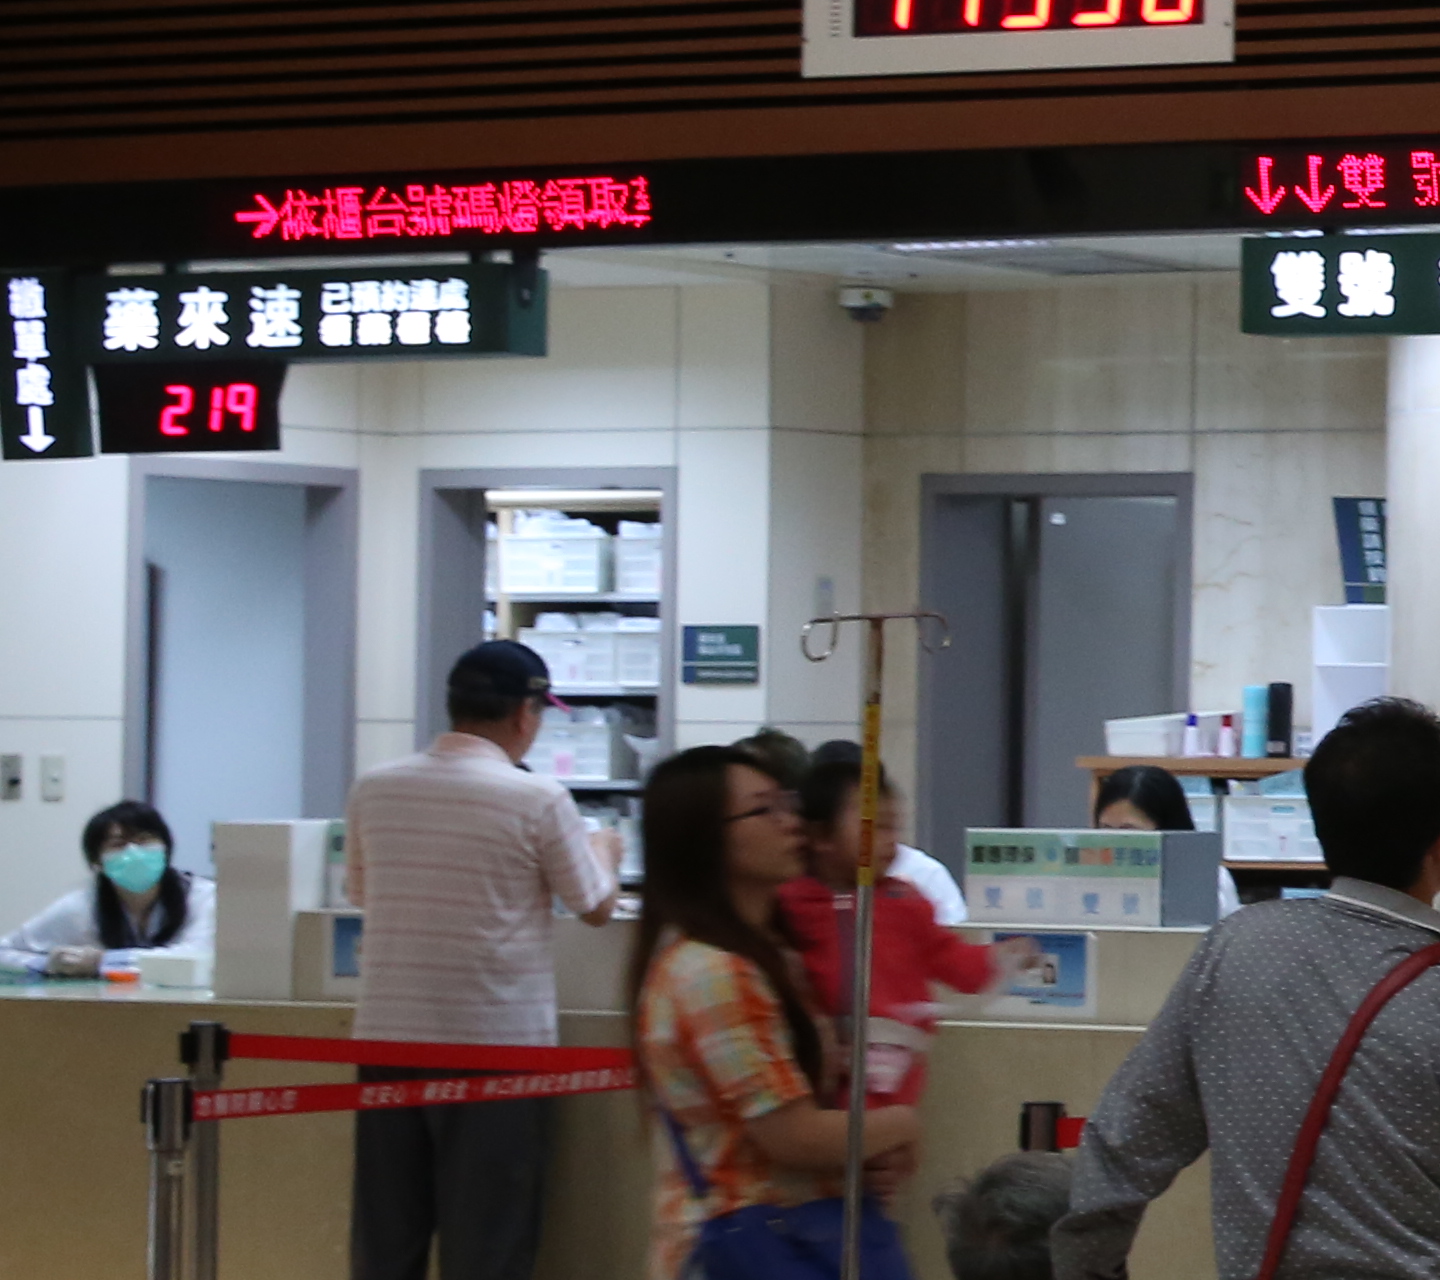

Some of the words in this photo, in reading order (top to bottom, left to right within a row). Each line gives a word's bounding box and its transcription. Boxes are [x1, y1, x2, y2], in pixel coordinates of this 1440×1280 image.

[1270, 248, 1396, 319] 雙號
[102, 285, 303, 352] 藥來速
[158, 381, 259, 437] 219
